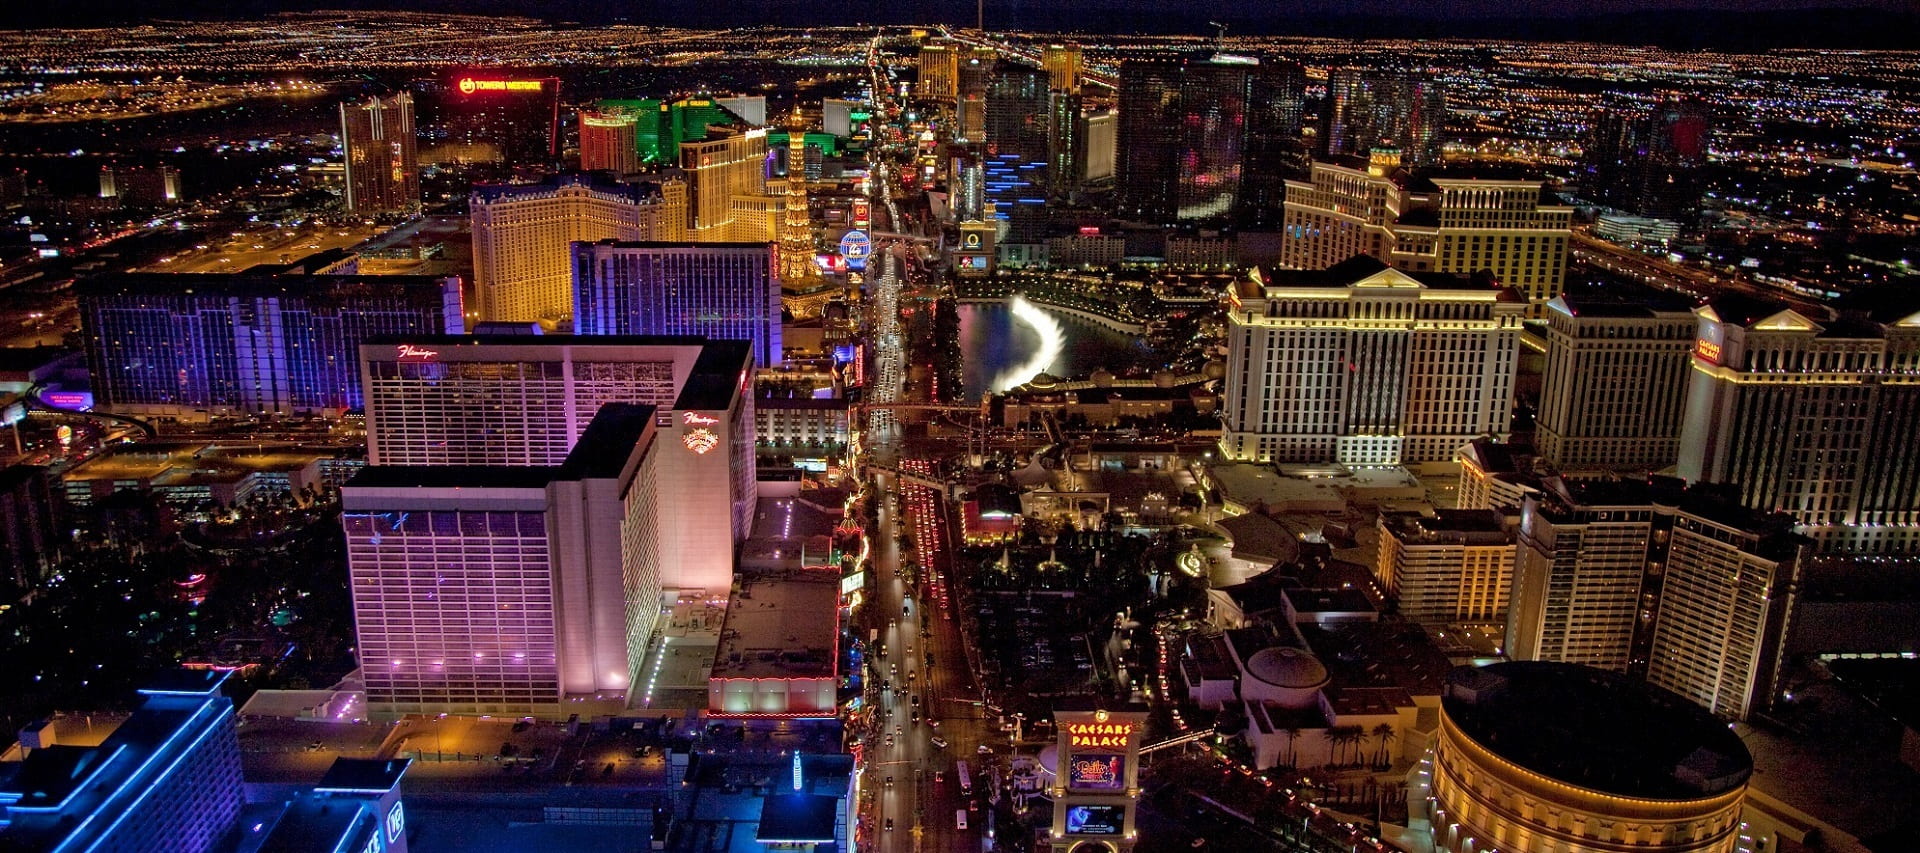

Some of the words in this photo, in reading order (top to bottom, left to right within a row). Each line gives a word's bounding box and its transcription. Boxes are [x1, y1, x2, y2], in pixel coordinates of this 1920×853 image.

[475, 81, 505, 90] TOWERS
[506, 81, 542, 91] WESTGATE
[396, 344, 438, 359] Flamingo
[1699, 339, 1720, 353] CAESARS
[1699, 346, 1718, 361] PALACE
[683, 411, 719, 425] Flamingo
[1069, 724, 1131, 735] CAESARS
[1072, 735, 1127, 746] PALACE
